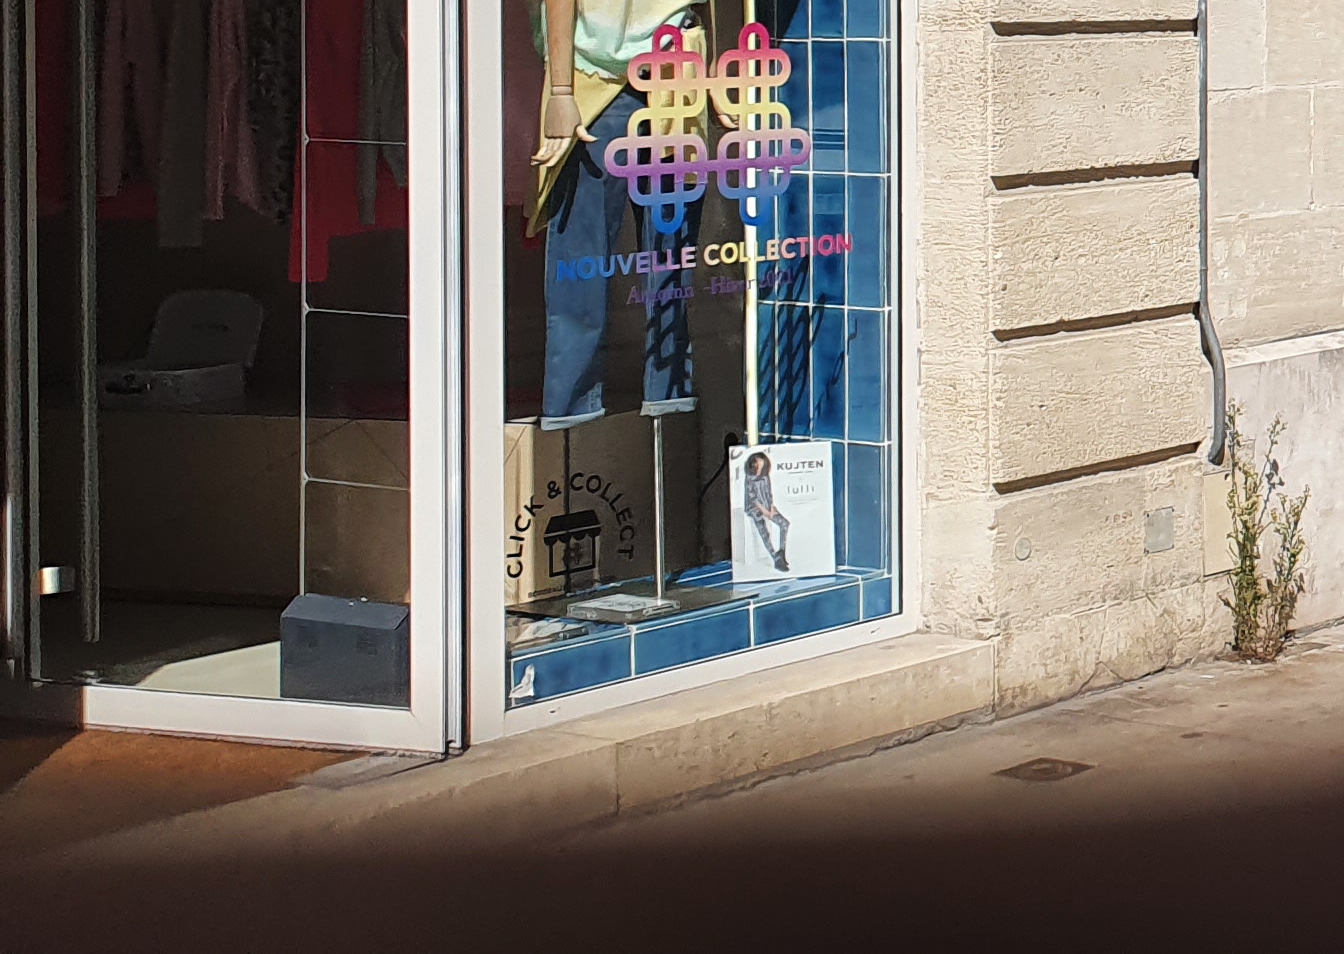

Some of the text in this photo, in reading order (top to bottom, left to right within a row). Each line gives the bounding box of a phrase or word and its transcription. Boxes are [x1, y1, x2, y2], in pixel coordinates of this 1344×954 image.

[556, 232, 853, 282] NOUVELLE COLLECTION
[776, 459, 824, 471] KUJTEN
[506, 472, 636, 579] CLICK & COLLECT
